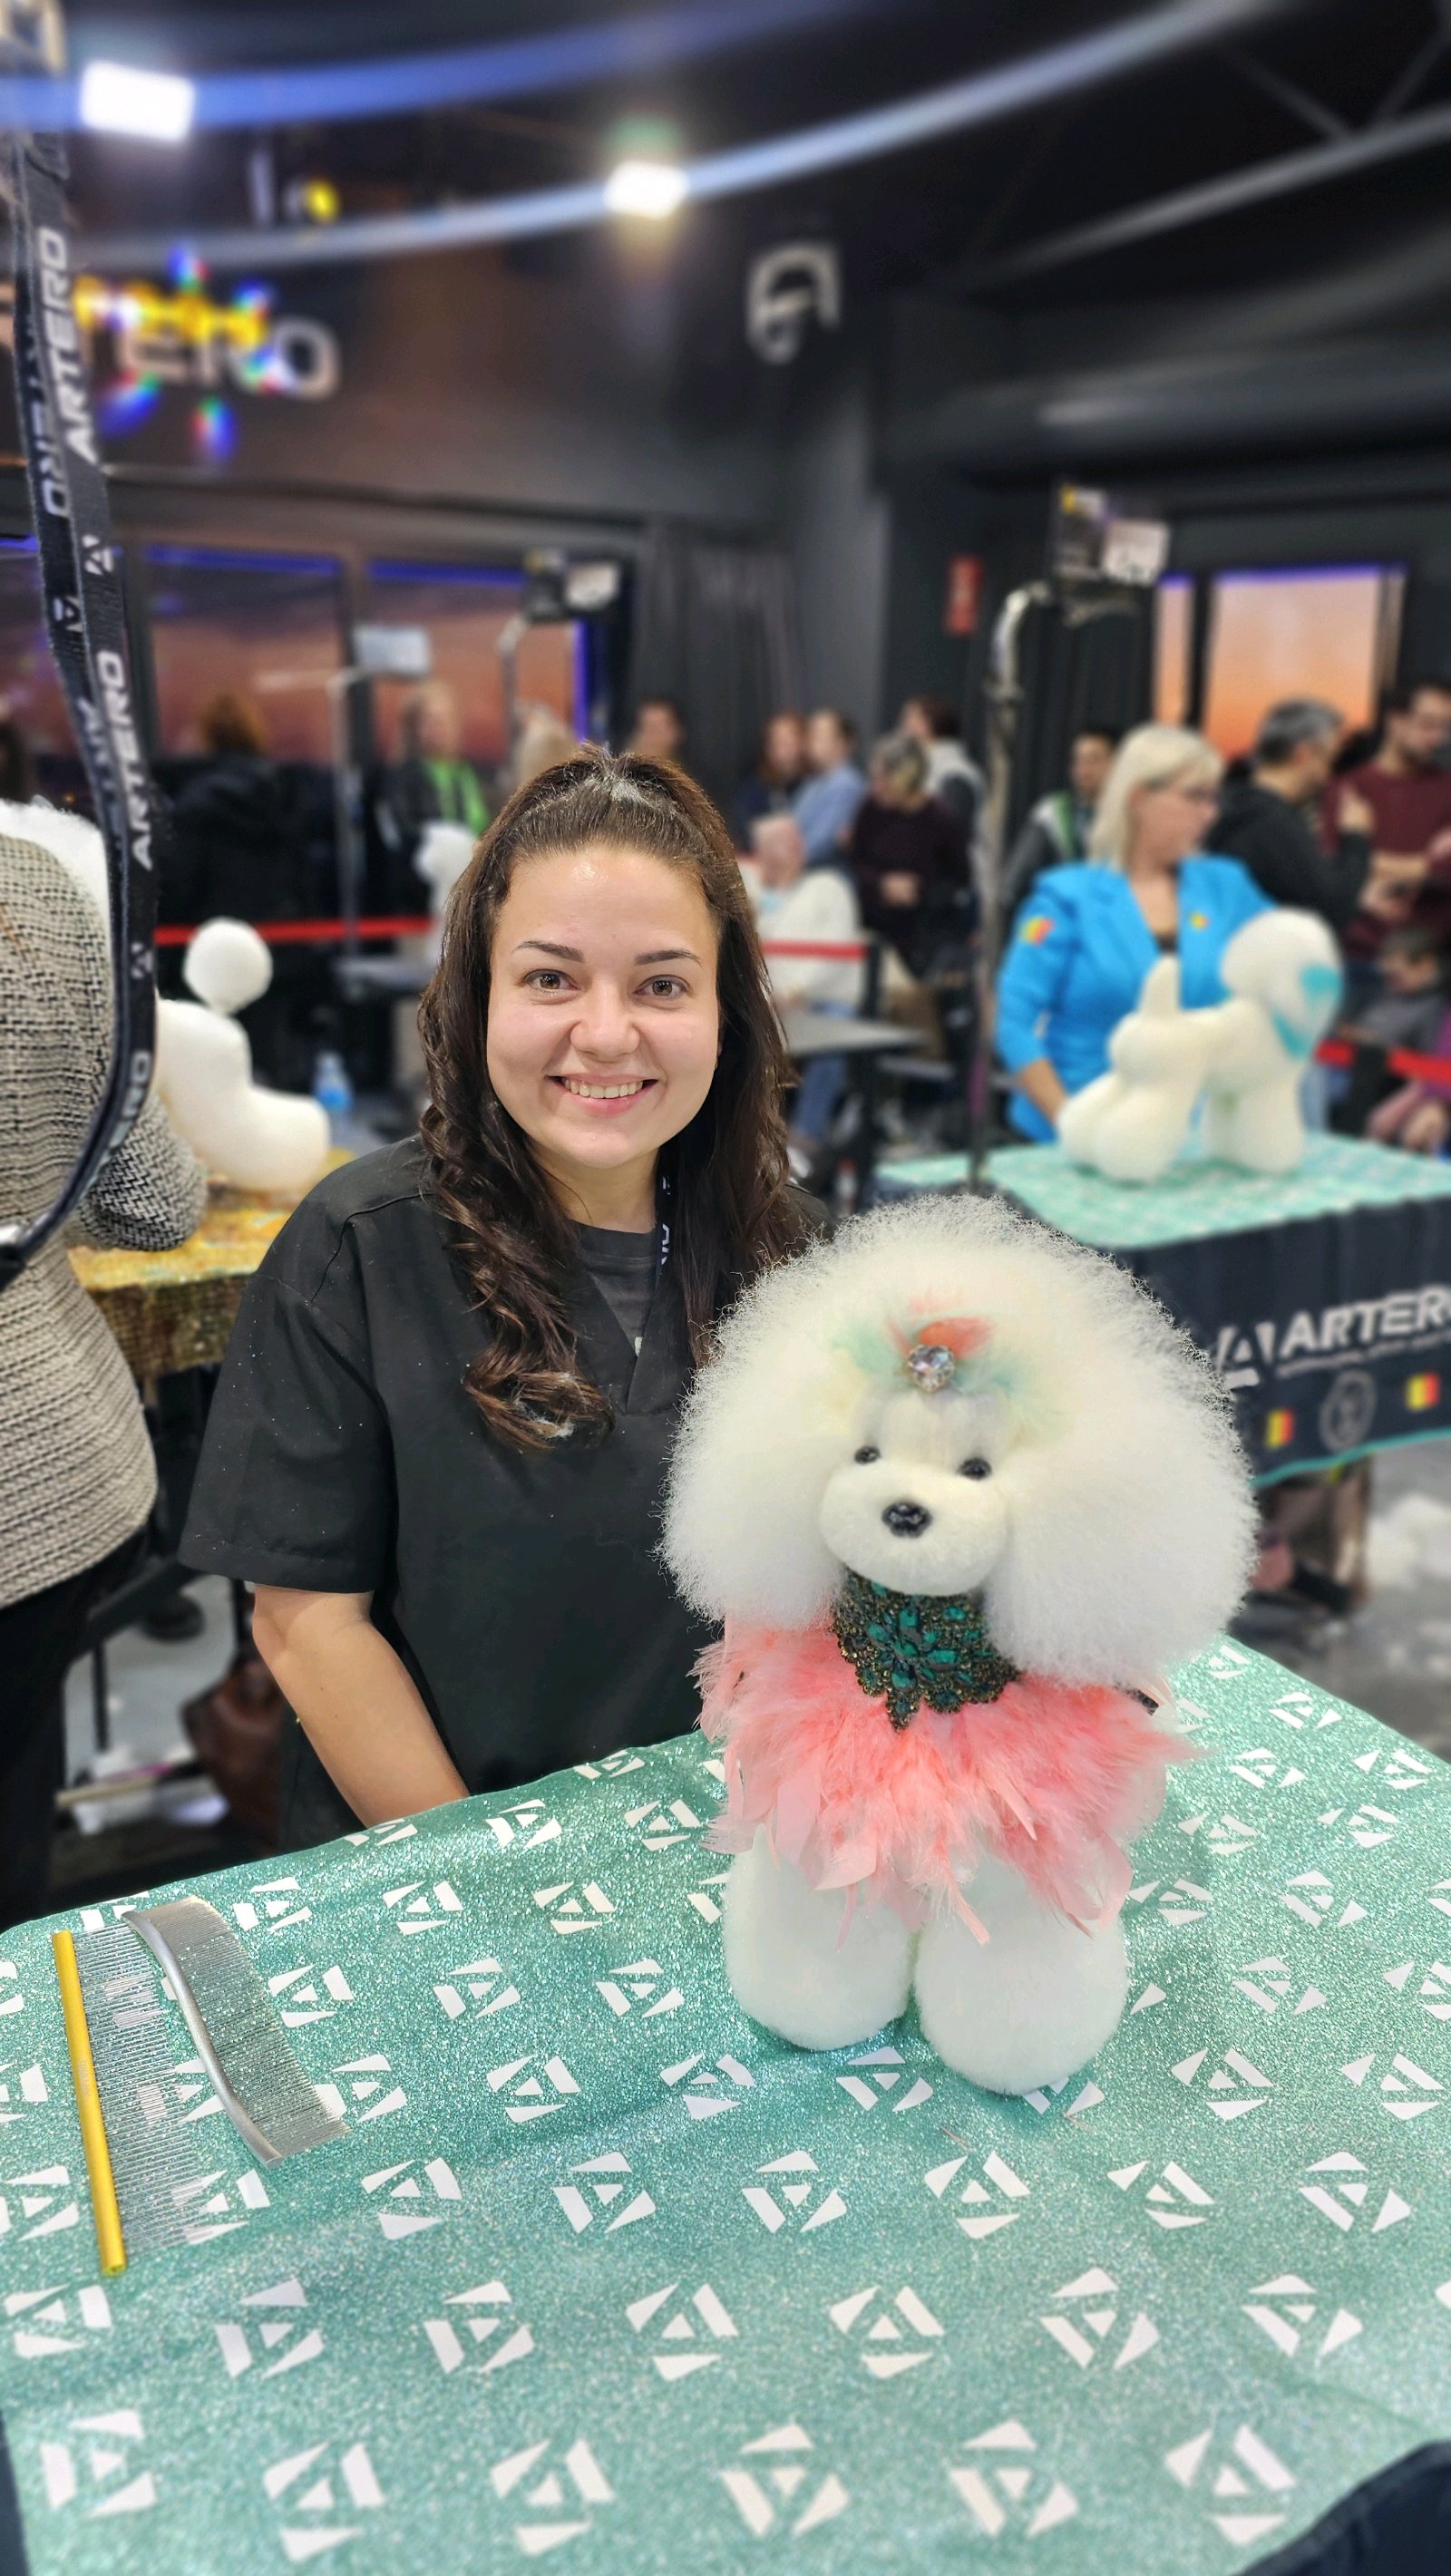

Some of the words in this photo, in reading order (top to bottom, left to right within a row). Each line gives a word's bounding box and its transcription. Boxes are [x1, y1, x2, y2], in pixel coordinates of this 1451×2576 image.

[38, 227, 97, 464] ARTERO
[96, 650, 152, 871] ARTERO
[1279, 1284, 1451, 1358] ARTER
